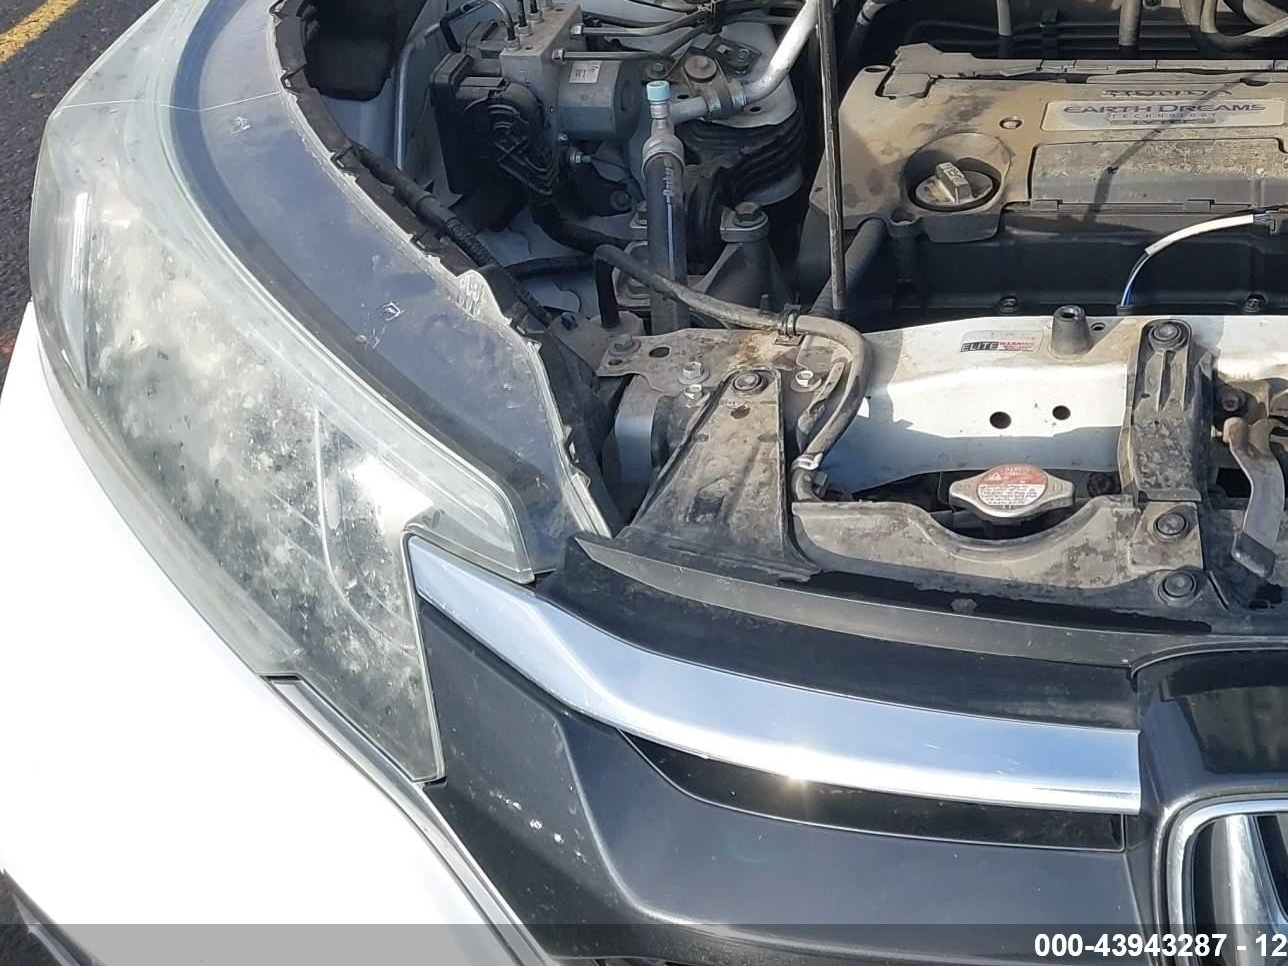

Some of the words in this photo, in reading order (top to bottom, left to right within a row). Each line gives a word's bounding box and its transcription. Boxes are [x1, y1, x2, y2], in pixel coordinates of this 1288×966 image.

[1063, 105, 1152, 114] EARTH
[1158, 103, 1266, 113] DREAMS
[962, 341, 998, 352] ELITE
